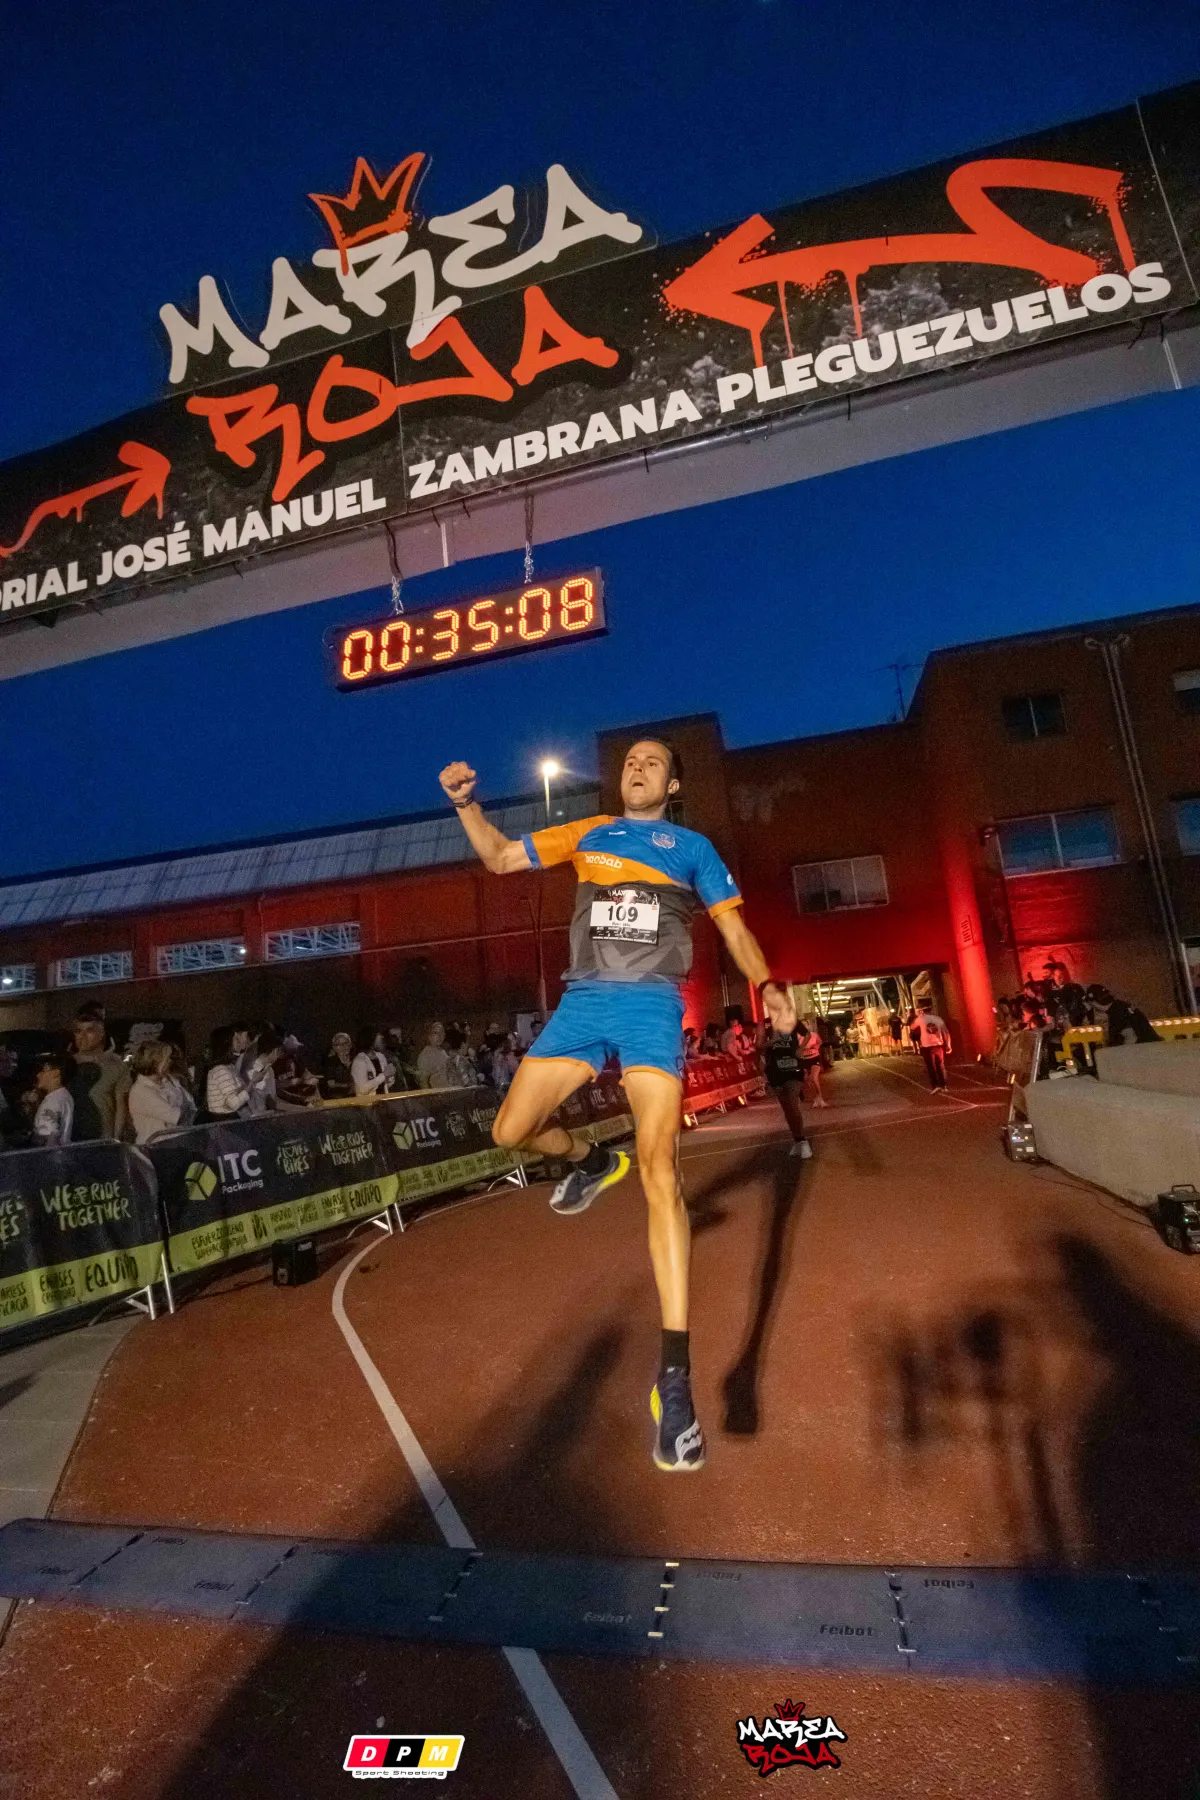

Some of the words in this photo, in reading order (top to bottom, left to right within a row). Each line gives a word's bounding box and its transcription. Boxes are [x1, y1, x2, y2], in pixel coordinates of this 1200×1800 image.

[158, 163, 643, 384] MAREA
[186, 285, 620, 502] ROJA
[0, 561, 88, 611] RIAL
[97, 520, 191, 585] JOSÉ
[203, 478, 386, 558] MANUEL
[409, 389, 703, 499] ZAMBRANA
[716, 262, 1172, 413] PLEGUEZUELOS
[342, 577, 593, 680] 00:35:08
[608, 905, 638, 922] 109
[410, 1117, 439, 1141] ITC
[217, 1149, 262, 1183] ITC
[330, 1142, 375, 1167] TOGETHER
[90, 1179, 121, 1202] RIDE
[222, 1179, 264, 1194] Packaging
[349, 1184, 382, 1210] EQUIPO
[57, 1197, 132, 1231] TOGETHER
[819, 1623, 874, 1637] Feibot
